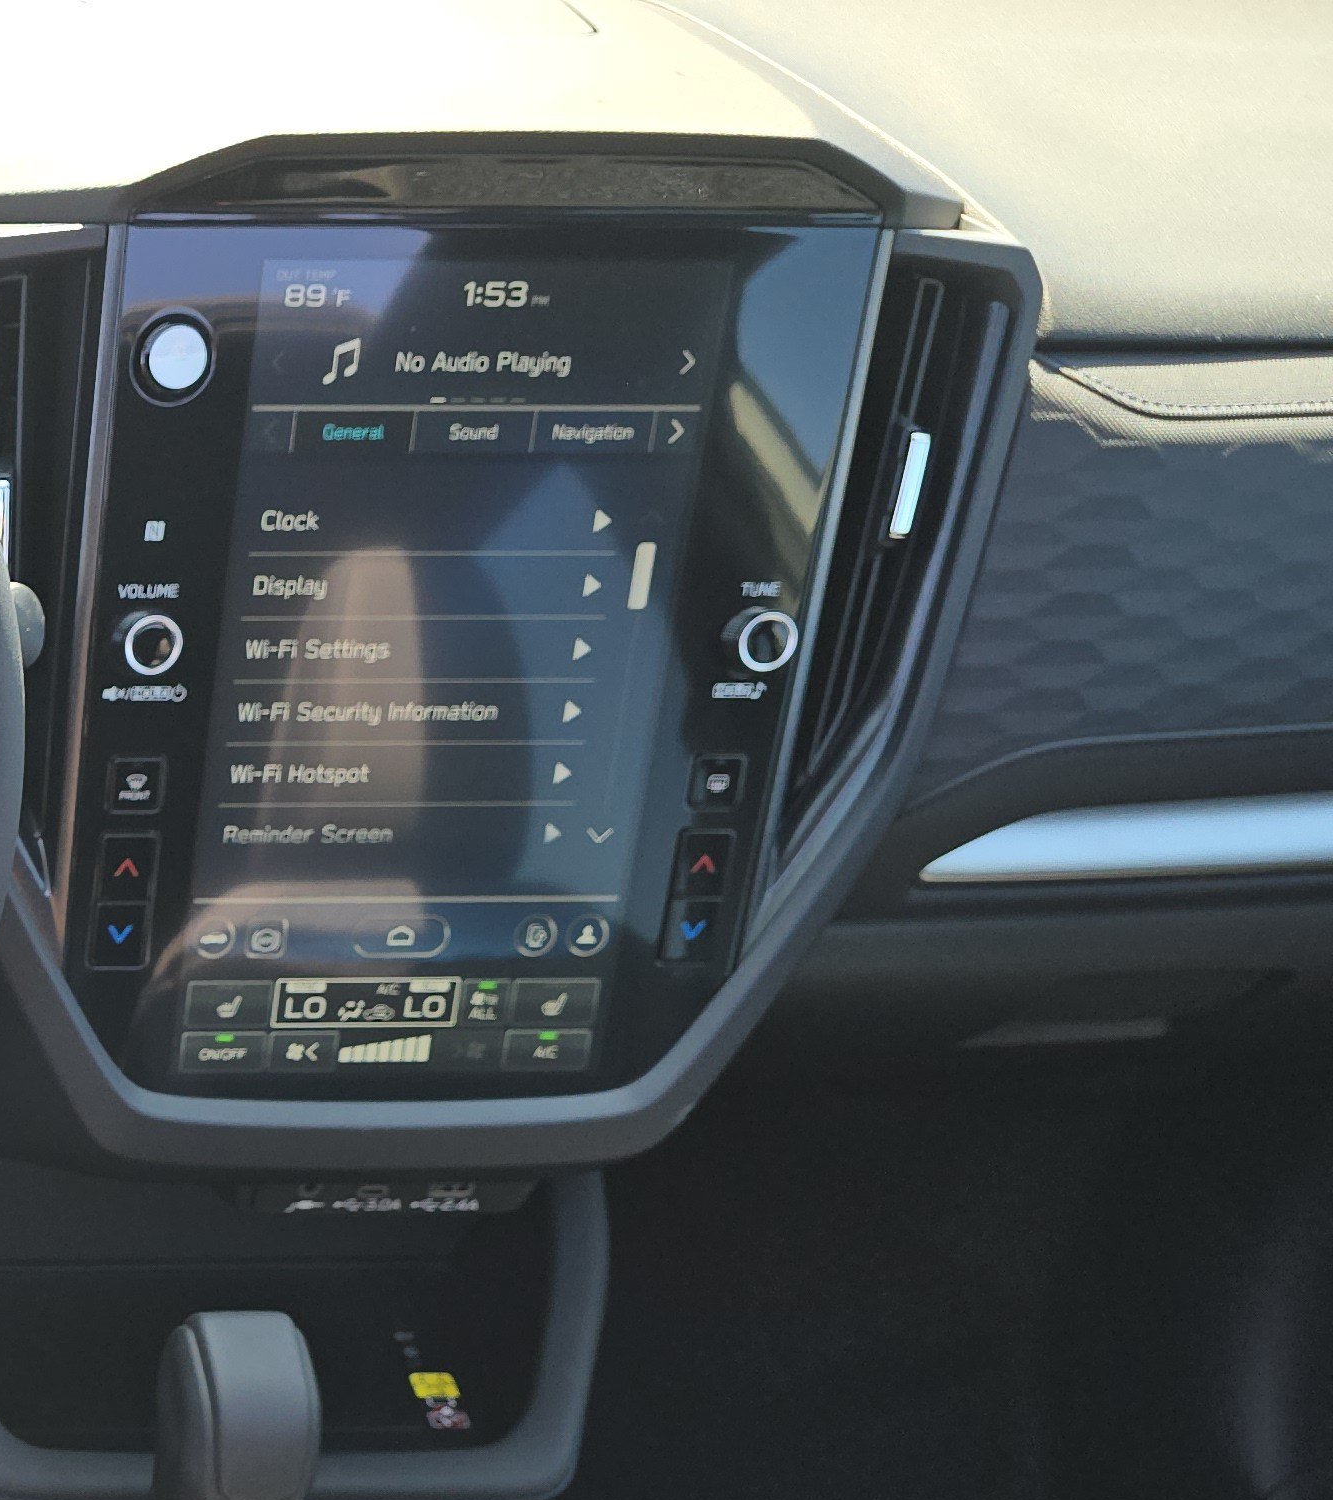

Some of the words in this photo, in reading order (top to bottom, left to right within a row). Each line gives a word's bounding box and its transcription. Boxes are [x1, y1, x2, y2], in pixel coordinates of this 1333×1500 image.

[283, 283, 327, 308] 89
[462, 280, 530, 308] 1:53
[394, 351, 426, 373] No
[430, 350, 490, 373] Audio
[496, 351, 572, 377] Playing
[322, 422, 384, 441] General
[448, 422, 500, 441] Sound
[551, 423, 635, 444] Navigation
[260, 509, 320, 532] Clock
[117, 583, 181, 600] VOLUME
[252, 574, 329, 600] Display
[740, 580, 783, 598] TUNE
[245, 637, 298, 660] Wi-Fi
[304, 637, 391, 664] Settings
[237, 701, 290, 722] Wi-Fi
[295, 701, 382, 726] Security
[387, 700, 500, 722] Information
[230, 763, 283, 784] Wi-Fi
[287, 764, 370, 787] Hotspot
[222, 824, 314, 845] Reminder
[320, 823, 394, 845] Screen
[283, 995, 328, 1020] LO
[402, 994, 447, 1019] LO
